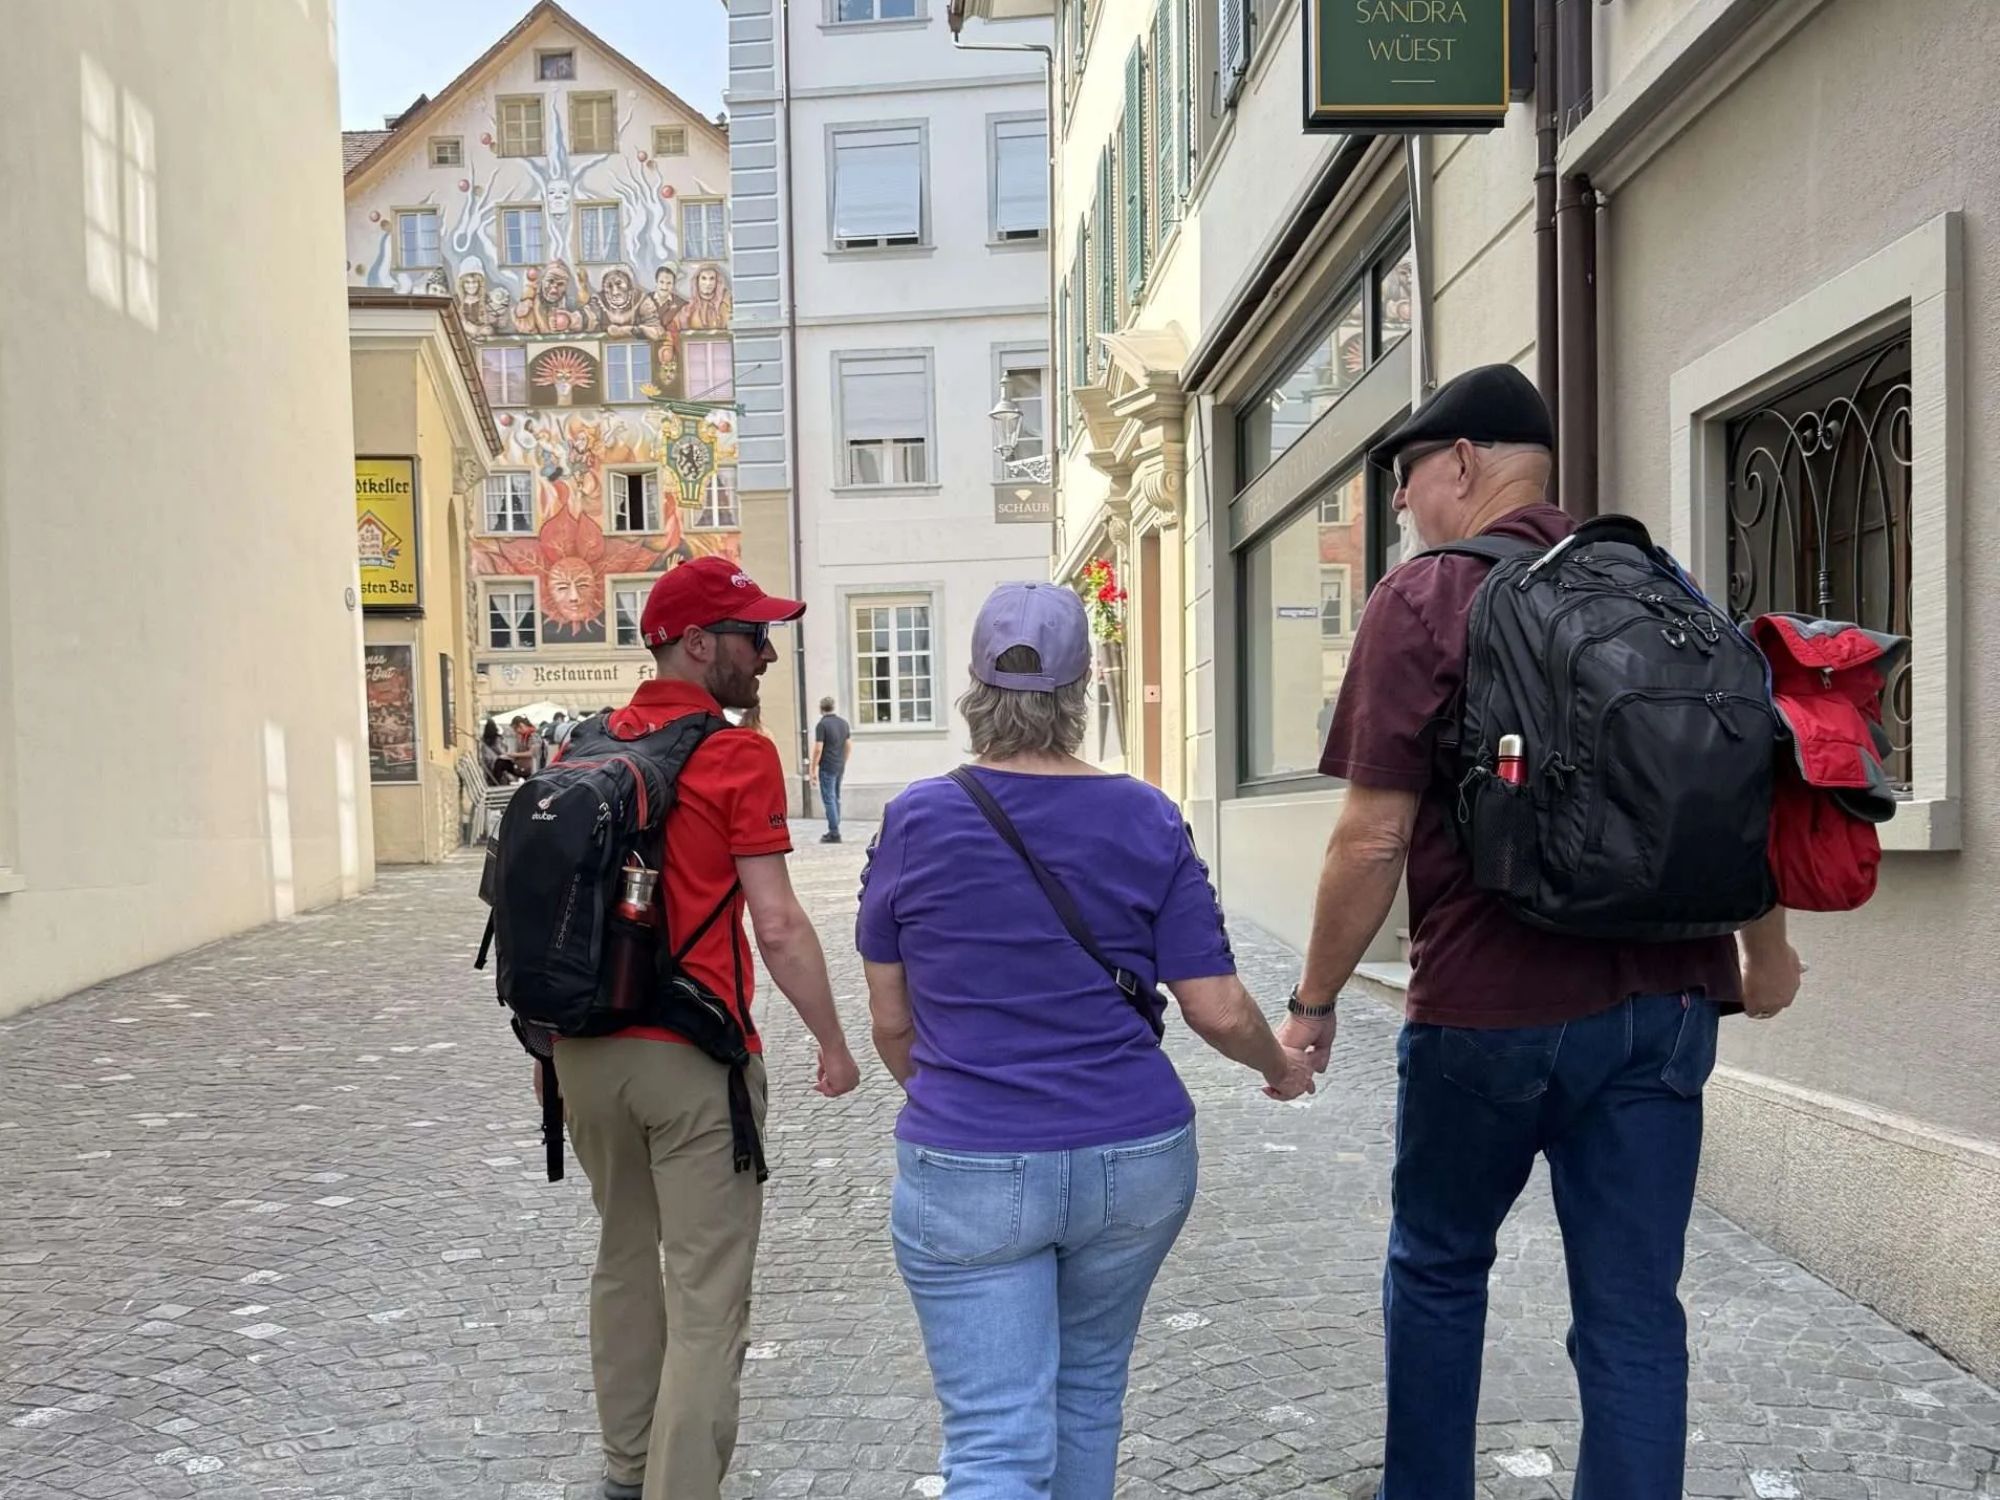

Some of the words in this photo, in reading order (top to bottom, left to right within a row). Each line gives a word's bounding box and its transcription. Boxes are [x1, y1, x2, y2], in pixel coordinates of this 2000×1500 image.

[1356, 0, 1467, 23] SANDRA
[1368, 34, 1457, 62] WÜEST
[998, 502, 1050, 513] SCHAUB
[389, 579, 414, 594] Bar
[534, 665, 618, 686] Restaurant
